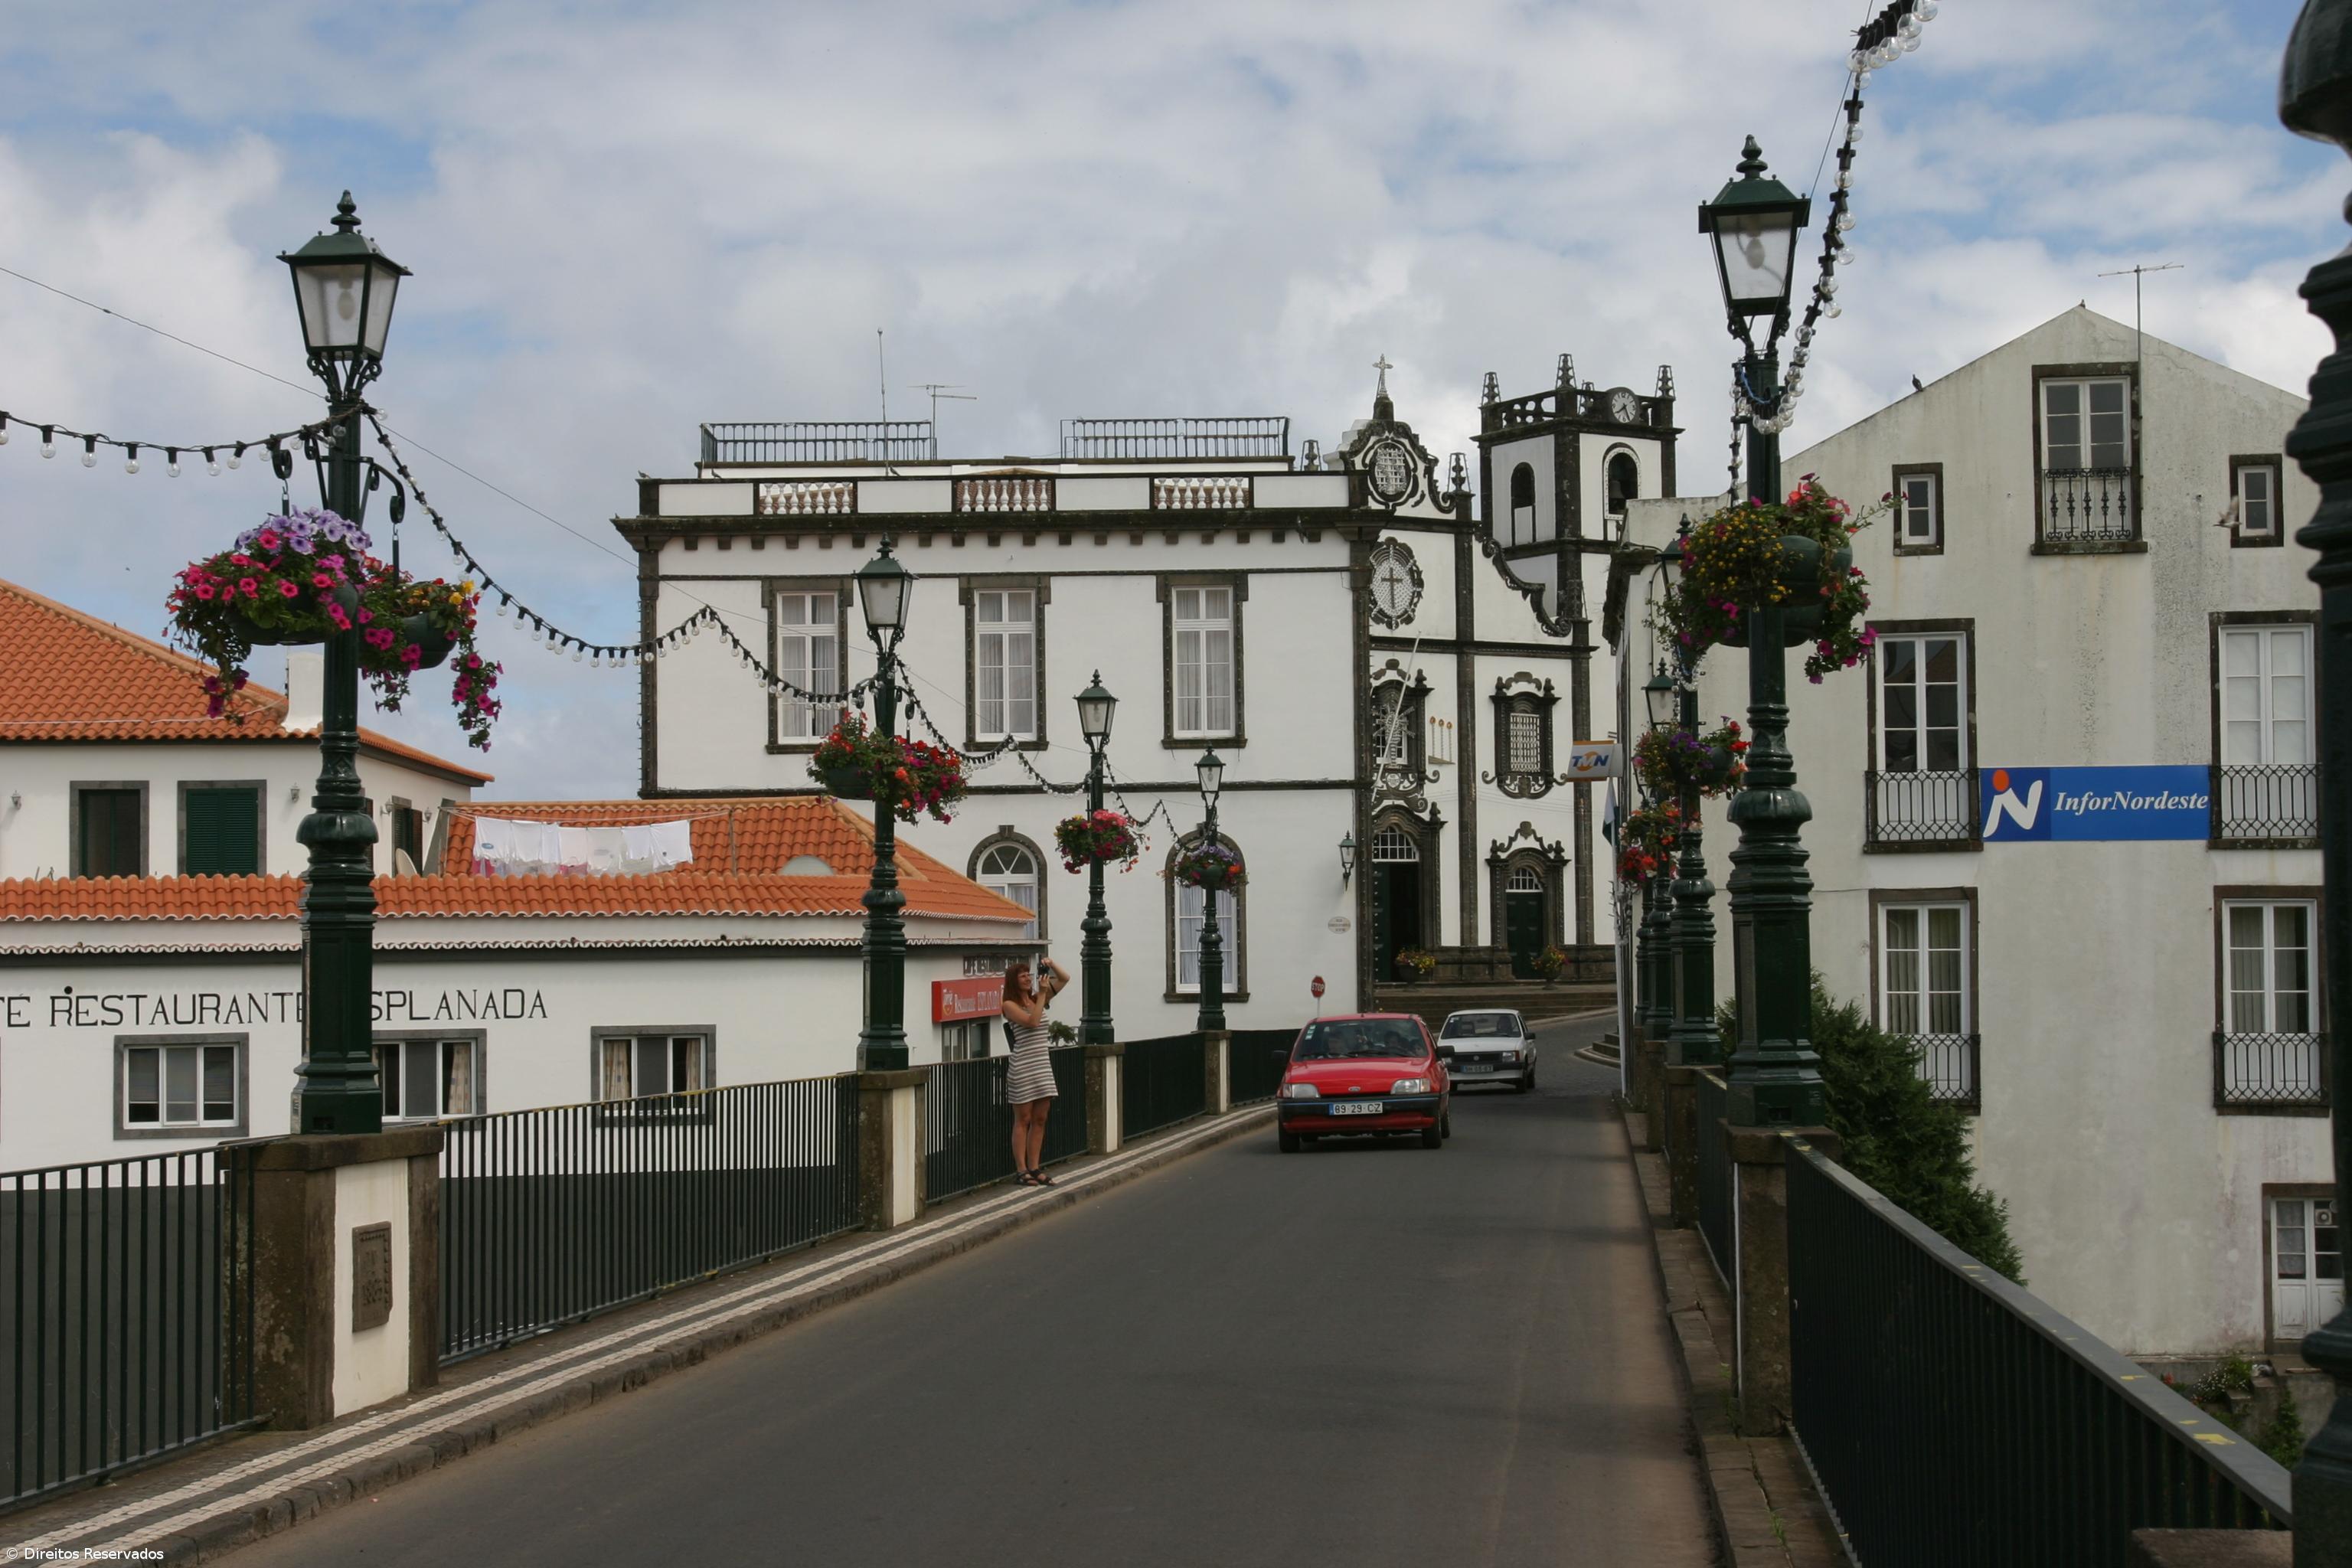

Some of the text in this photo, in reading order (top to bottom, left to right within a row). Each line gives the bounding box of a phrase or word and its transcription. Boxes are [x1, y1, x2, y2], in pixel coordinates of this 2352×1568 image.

[2053, 791, 2209, 815] InforNordeste
[1311, 982, 1325, 992] STOP
[371, 988, 548, 1021] SPLANADA
